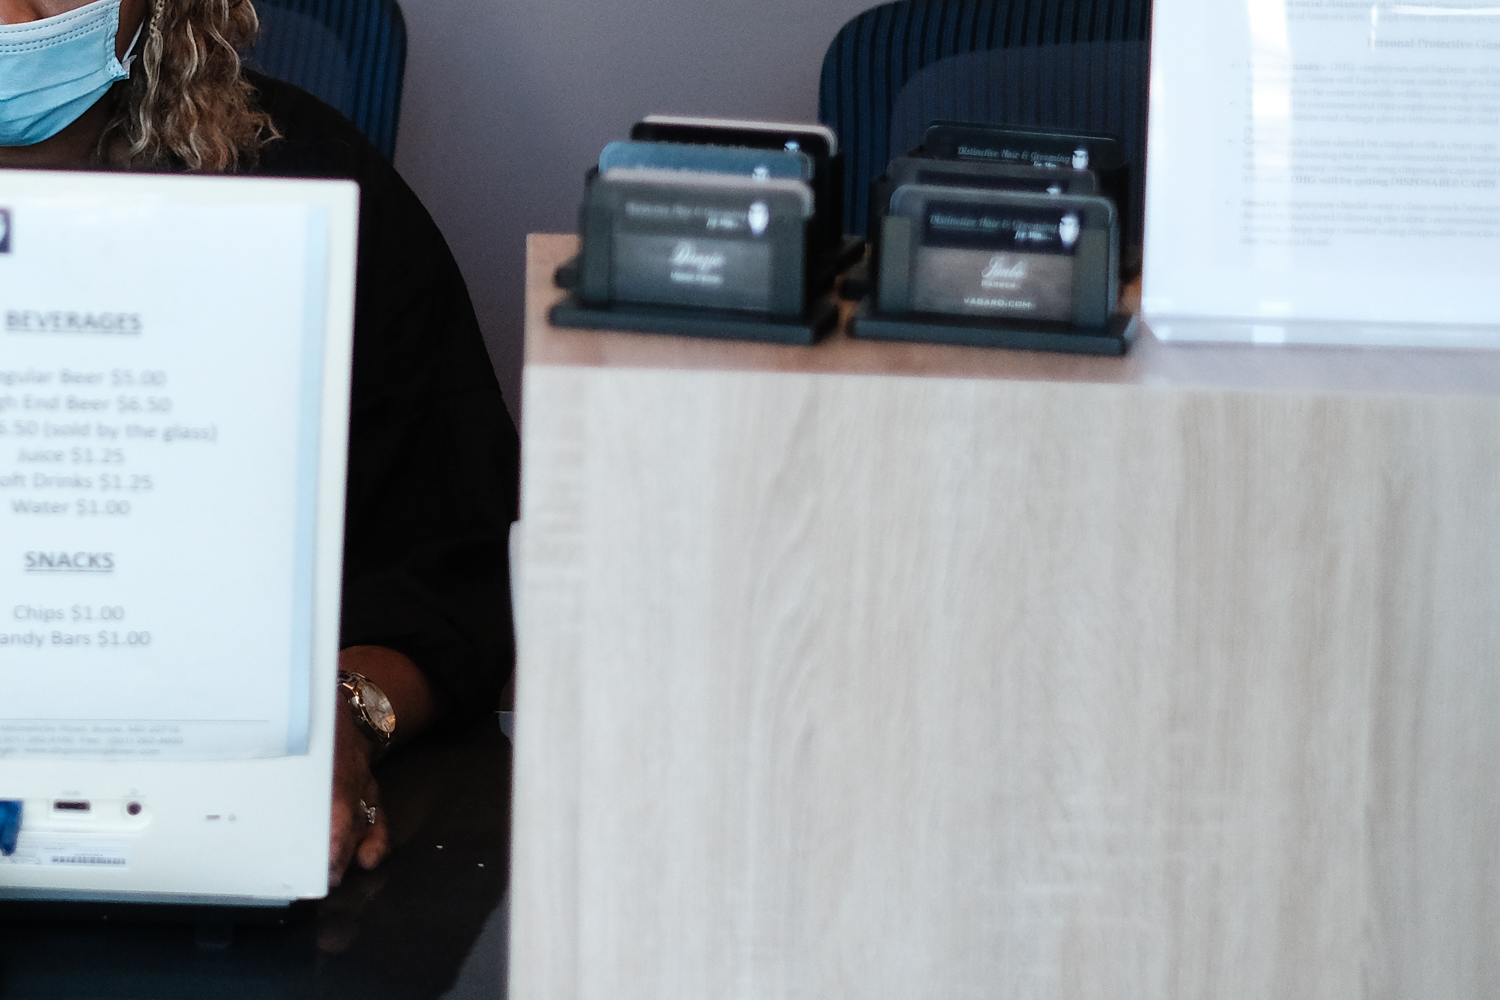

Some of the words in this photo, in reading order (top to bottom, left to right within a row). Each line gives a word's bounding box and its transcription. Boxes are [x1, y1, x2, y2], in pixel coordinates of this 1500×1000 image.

[4, 311, 143, 331] BEVERAGES
[60, 368, 103, 385] Beer
[111, 368, 167, 387] $5.00
[23, 394, 61, 411] End
[66, 394, 109, 411] Beer
[116, 395, 173, 414] $6.50
[43, 420, 91, 439] (sold
[96, 421, 119, 440] by
[125, 421, 157, 439] the
[163, 423, 218, 444] glass)
[17, 448, 65, 464] Juice
[71, 448, 125, 465] $1.25
[32, 473, 93, 489] Drinks
[99, 473, 154, 491] $1.25
[10, 499, 69, 516] Water
[76, 499, 131, 517] $1.00
[24, 551, 116, 571] SNACKS
[12, 604, 65, 622] Chips
[70, 604, 125, 622] $1.00
[51, 630, 91, 646] Bars
[98, 630, 152, 648] $1.00
